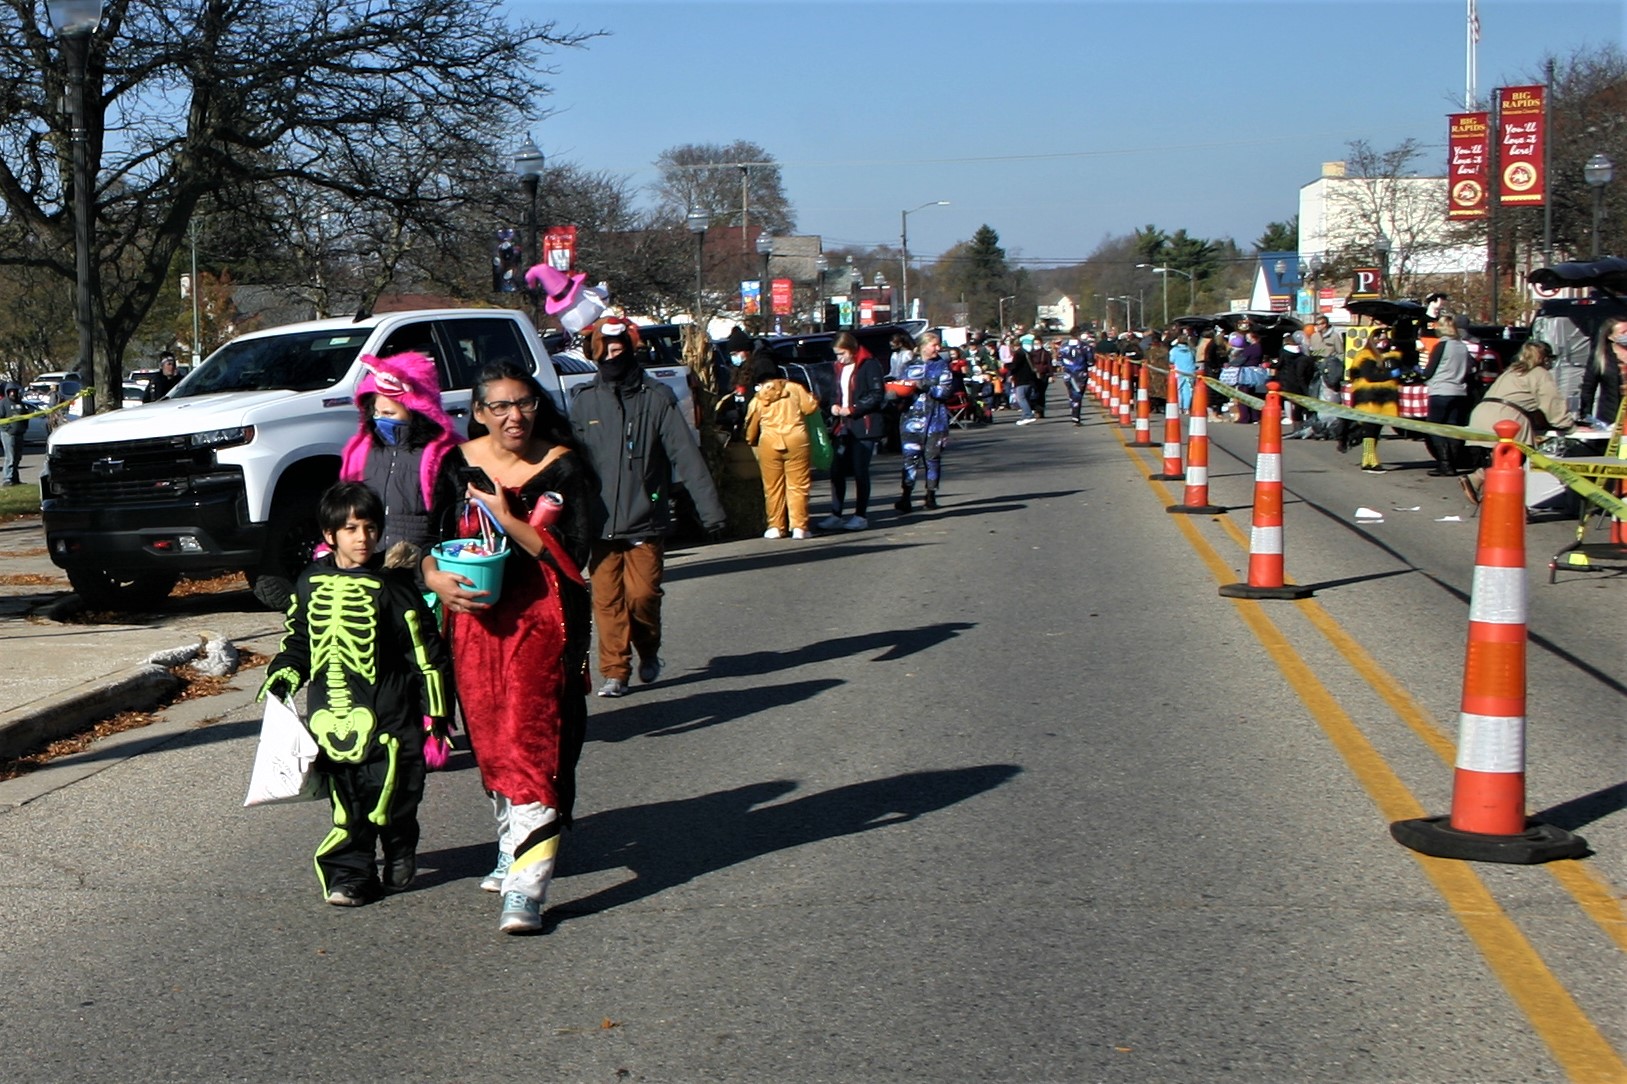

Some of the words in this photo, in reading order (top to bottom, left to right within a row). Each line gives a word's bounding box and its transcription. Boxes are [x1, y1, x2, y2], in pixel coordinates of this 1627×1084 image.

[1512, 92, 1530, 100] BIG
[1503, 98, 1540, 108] RAPIDS
[1505, 122, 1536, 134] You'll
[1358, 272, 1374, 292] P
